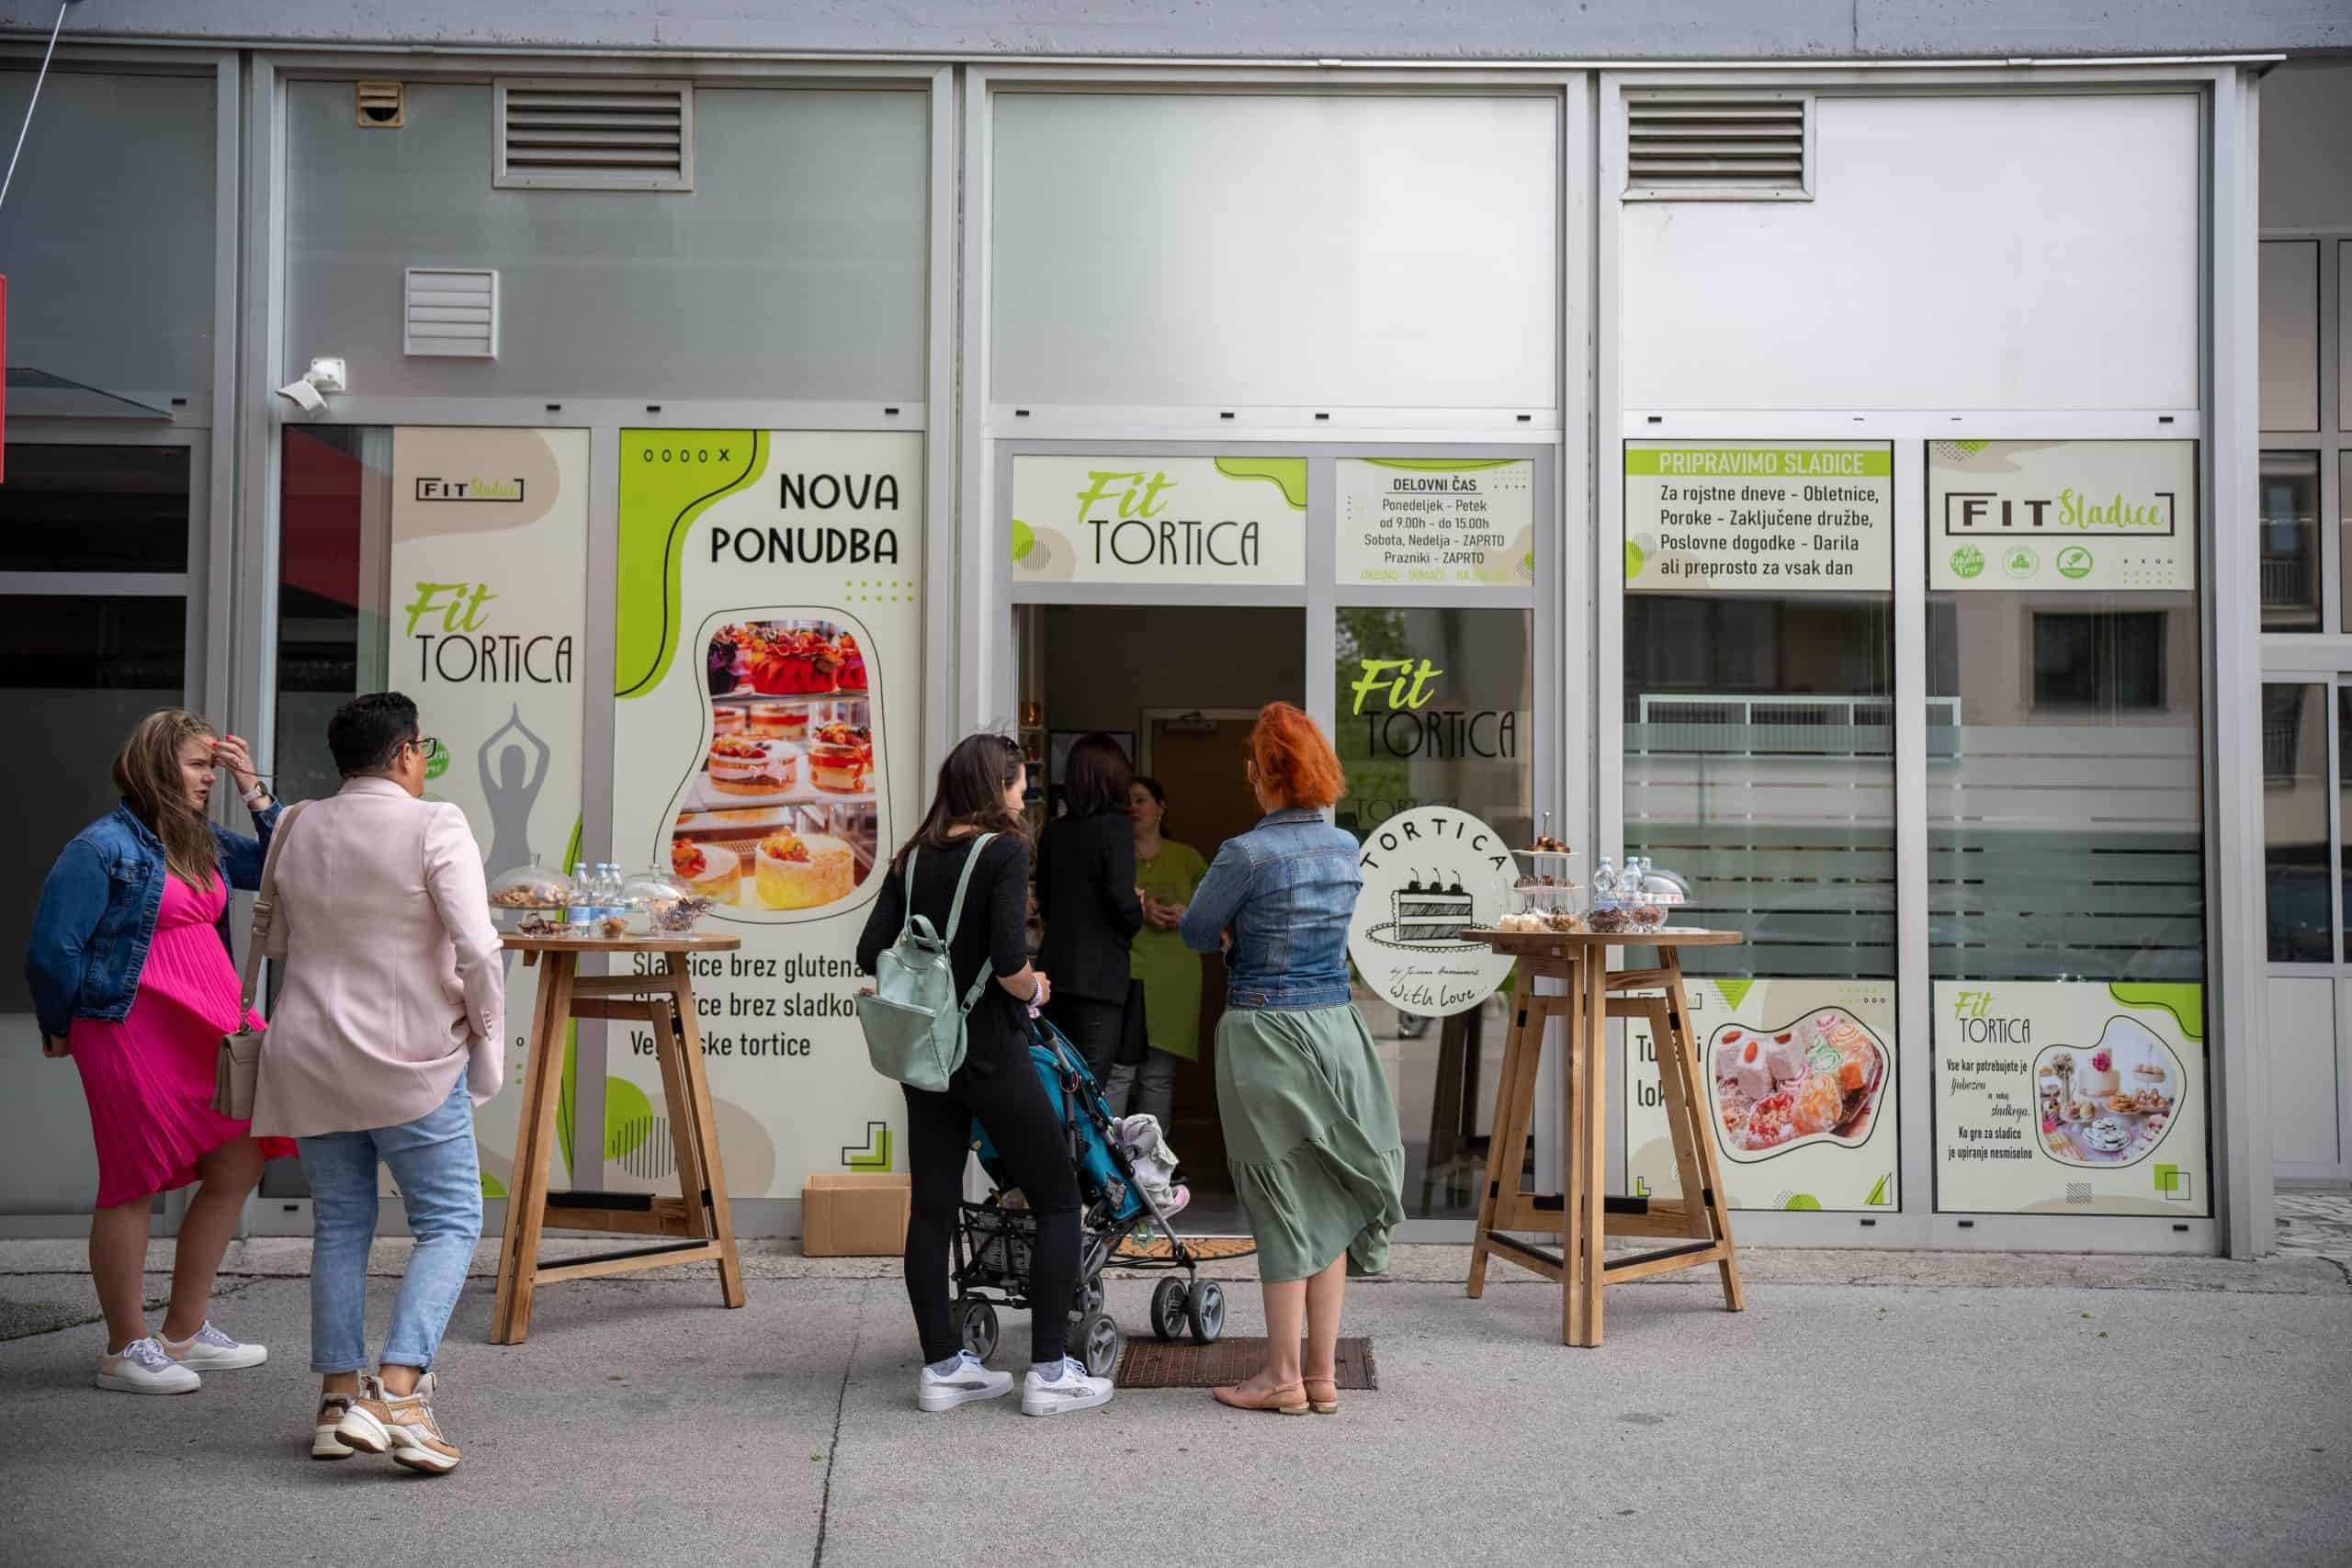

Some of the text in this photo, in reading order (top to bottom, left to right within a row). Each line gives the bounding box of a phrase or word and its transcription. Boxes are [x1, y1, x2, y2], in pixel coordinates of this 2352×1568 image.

[1659, 452, 1865, 474] PRIPRAVIMO SLADICE
[424, 483, 469, 497] FIT
[780, 473, 899, 510] NOVA
[1394, 475, 1476, 491] DELOVNI ČAS
[1660, 485, 1678, 501] Za
[1683, 485, 1736, 504] rojstne
[1741, 485, 1786, 502] dneve
[1804, 485, 1880, 504] Obletnice,
[1076, 470, 1177, 525] Fit
[1382, 499, 1443, 514] Ponedeljek
[1455, 499, 1487, 512] Petek
[1962, 488, 2165, 530] FIT Sladice
[1380, 517, 1393, 528] od
[1396, 517, 1426, 528] 9.00h
[1438, 517, 1452, 529] do
[1455, 517, 1489, 529] 15.00h
[1660, 509, 1712, 525] Poroke
[1729, 509, 1812, 529] Zaključene
[1817, 509, 1873, 529] družbe,
[710, 527, 899, 565] PONUDBA
[1088, 520, 1259, 566] TORTICA
[1364, 534, 1406, 547] Sobota,
[1408, 534, 1451, 549] Nedelja
[1463, 535, 1505, 547] ZAPRTO
[1660, 534, 1727, 550] Poslovne
[1733, 534, 1796, 554] dogodke
[1813, 535, 1859, 550] Darila
[1385, 551, 1430, 564] Prazniki
[1442, 552, 1485, 564] ZAPRTO
[1660, 558, 1853, 579] ali preprosto za vsak dan
[404, 581, 500, 638] Fit
[415, 635, 572, 683] TORTICA
[1351, 659, 1443, 716] Fit
[1363, 710, 1516, 758] TORTICA
[1360, 818, 1507, 872] TORTICA
[633, 953, 865, 984] Slaice brez glutena
[730, 992, 775, 1017] brez
[784, 992, 860, 1017] sladko
[1955, 991, 1996, 1019] Fit
[1960, 1018, 2030, 1043] TORTICA
[740, 1032, 810, 1056] tortice
[1947, 1058, 2028, 1075] Vse kar potrebujete je
[1970, 1129, 1983, 1142] gre
[1984, 1129, 1993, 1139] za
[1995, 1127, 2021, 1139] sladico
[1948, 1146, 2032, 1161] je upiranje nesmiselno
